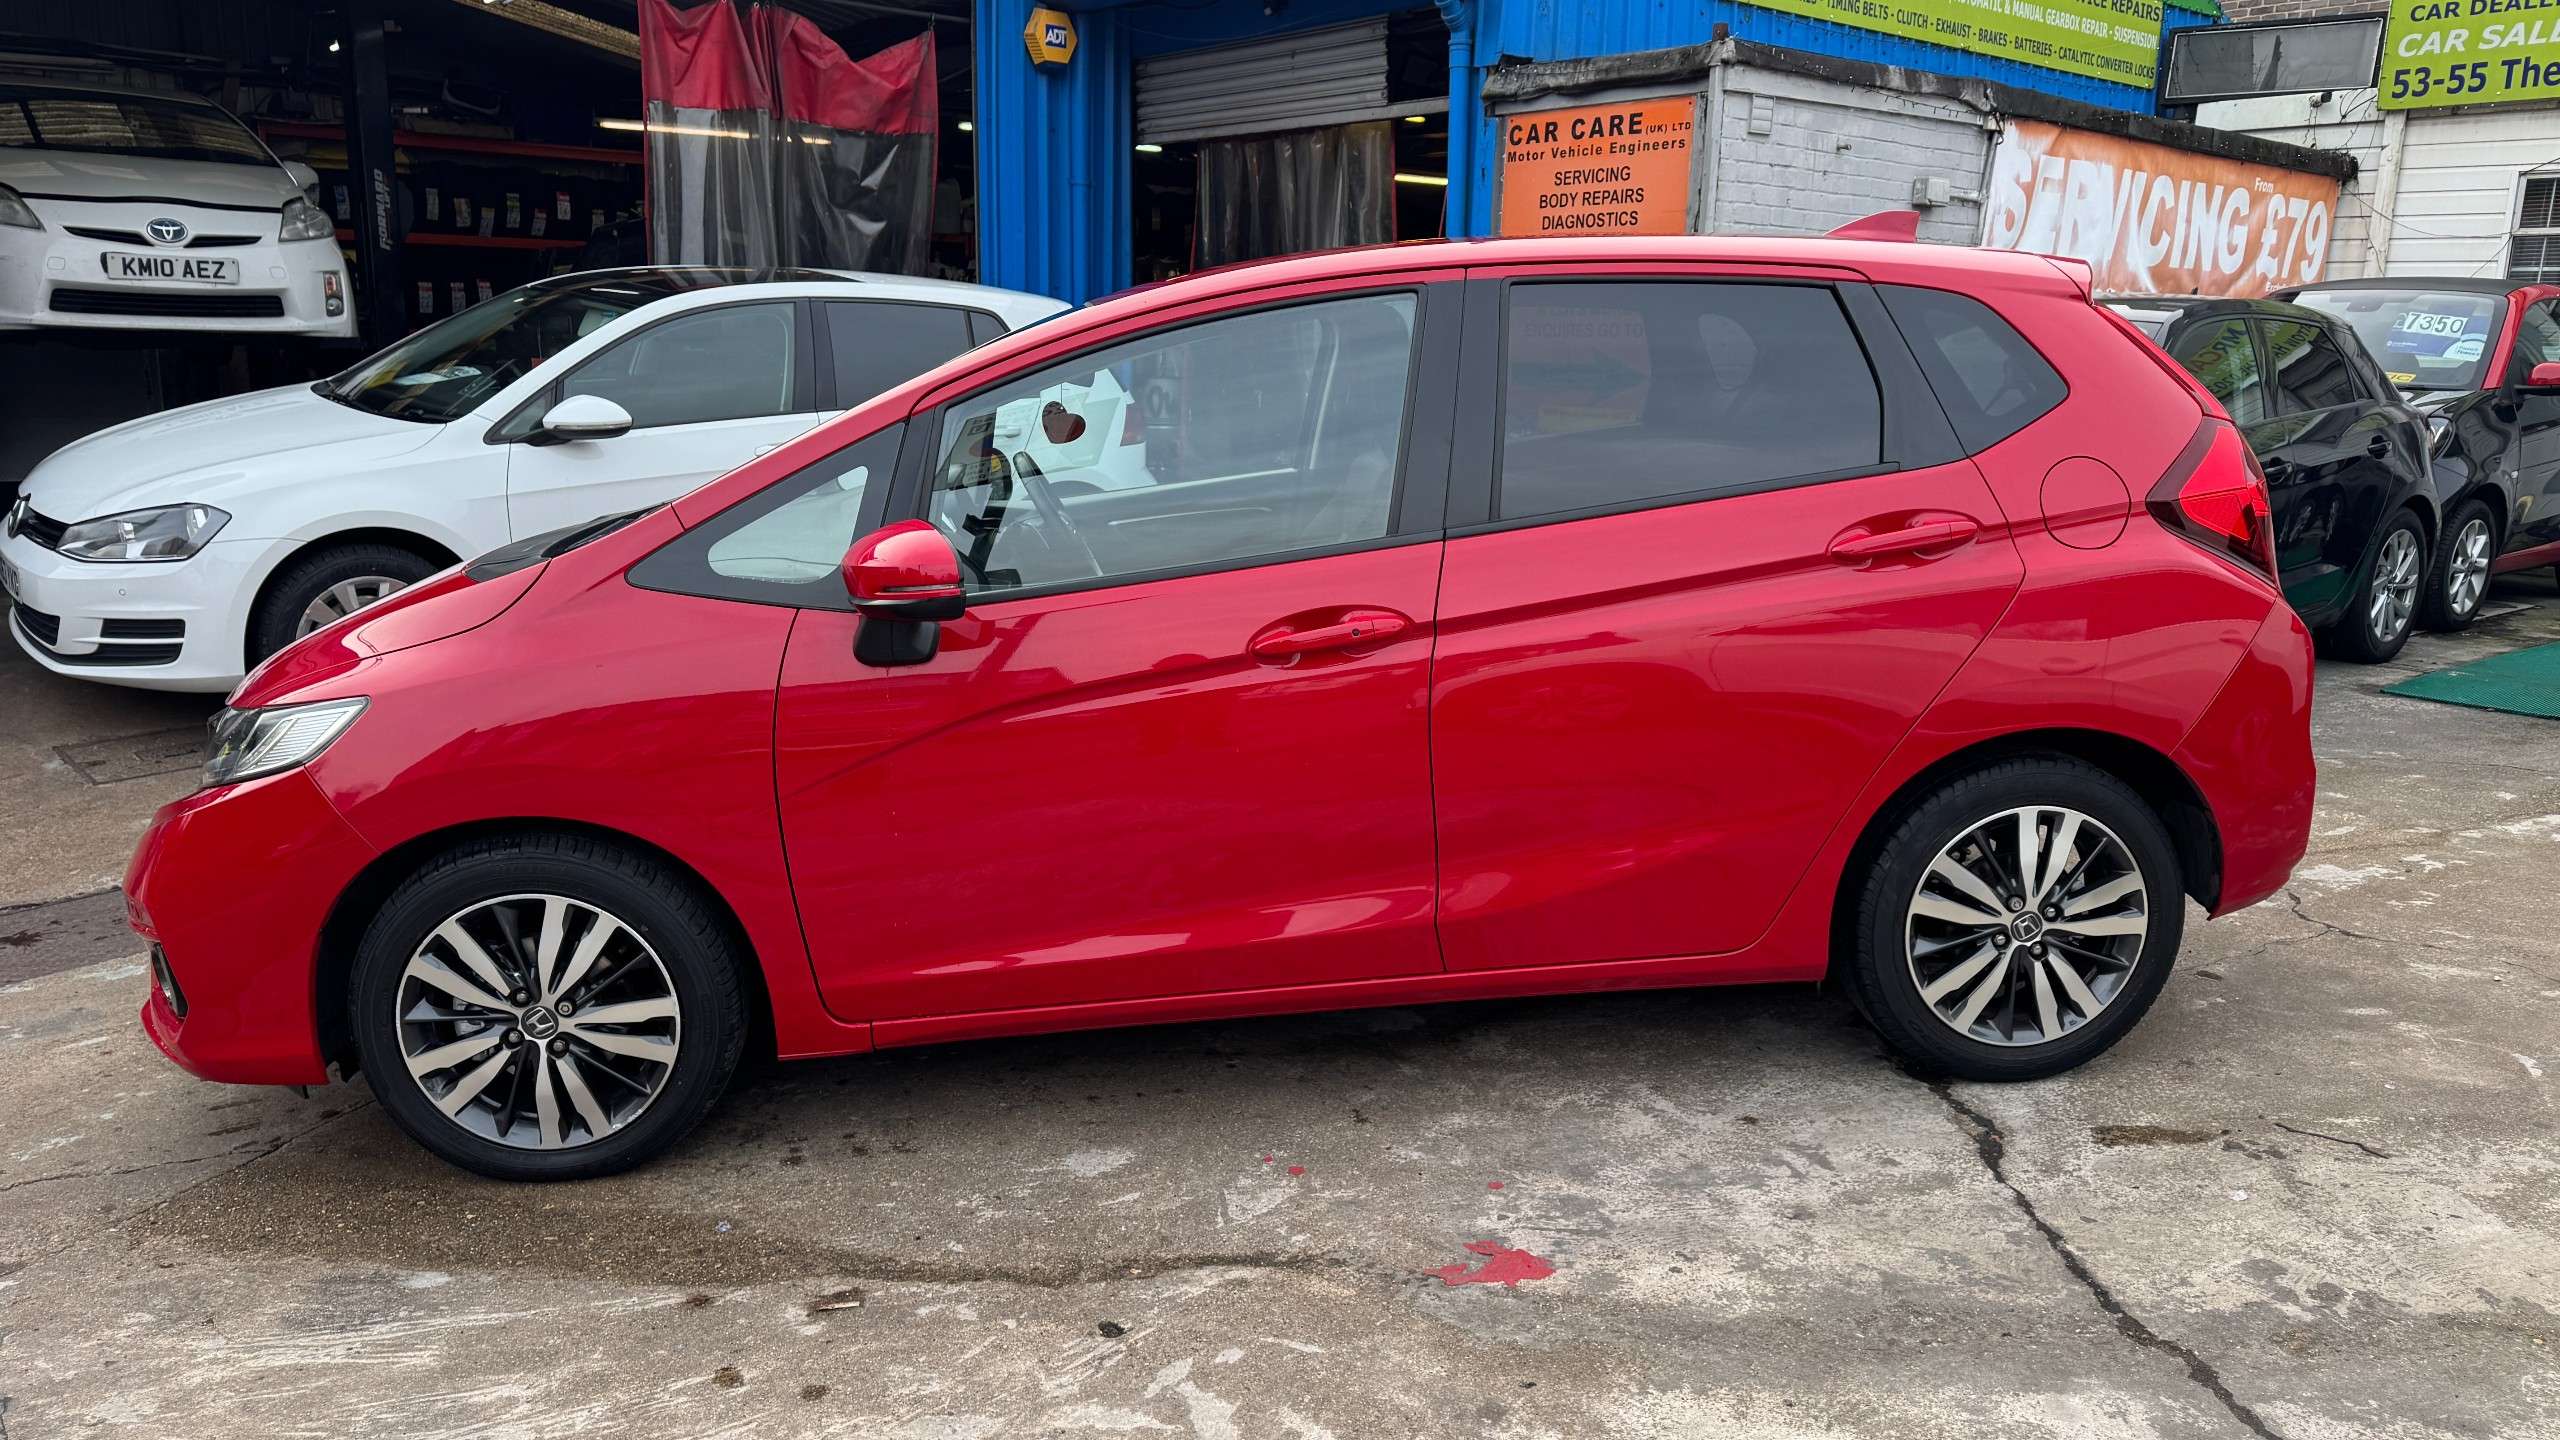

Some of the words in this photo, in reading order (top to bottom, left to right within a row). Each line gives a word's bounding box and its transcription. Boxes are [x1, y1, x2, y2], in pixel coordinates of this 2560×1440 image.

[2111, 0, 2160, 22] REPAIRS
[2410, 1, 2460, 22] CAR
[2012, 1, 2044, 22] MANUAL
[2046, 8, 2080, 31] GEARBOX
[2081, 17, 2108, 38] REPAIR
[2113, 25, 2160, 48] SUSPENSION
[1045, 28, 1067, 45] ADT
[1827, 0, 1860, 14] TIMING
[1862, 1, 1889, 20] BELTS
[1896, 9, 1928, 29] CLUTCH
[1936, 18, 1972, 39] EXHAUST
[1978, 28, 2008, 47] BRAKES
[2014, 36, 2053, 56] BATTERIES
[2058, 46, 2095, 66] CATALYTIC
[2096, 54, 2133, 74] CONVERTER
[2134, 63, 2155, 79] LOCKS
[2398, 28, 2469, 57] CAR
[2391, 62, 2489, 99] 53-55
[2500, 56, 2560, 89] The
[1509, 121, 1559, 146] CAR
[1571, 112, 1643, 140] CARE
[1645, 123, 1668, 135] (UK)
[1672, 121, 1691, 131] LTD
[1507, 151, 1545, 163] Motor
[1551, 143, 1603, 159] Vehicle
[1609, 138, 1686, 156] Engineers
[1554, 166, 1631, 186] SERVICING
[2254, 177, 2274, 193] From
[1539, 192, 1579, 209] BODY
[1582, 188, 1644, 206] REPAIRS
[1542, 210, 1638, 230] DIAGNOSTICS
[1991, 148, 2250, 275] SERVICING
[2255, 193, 2328, 282] £79
[121, 257, 174, 278] KM10
[182, 259, 226, 279] AEZ
